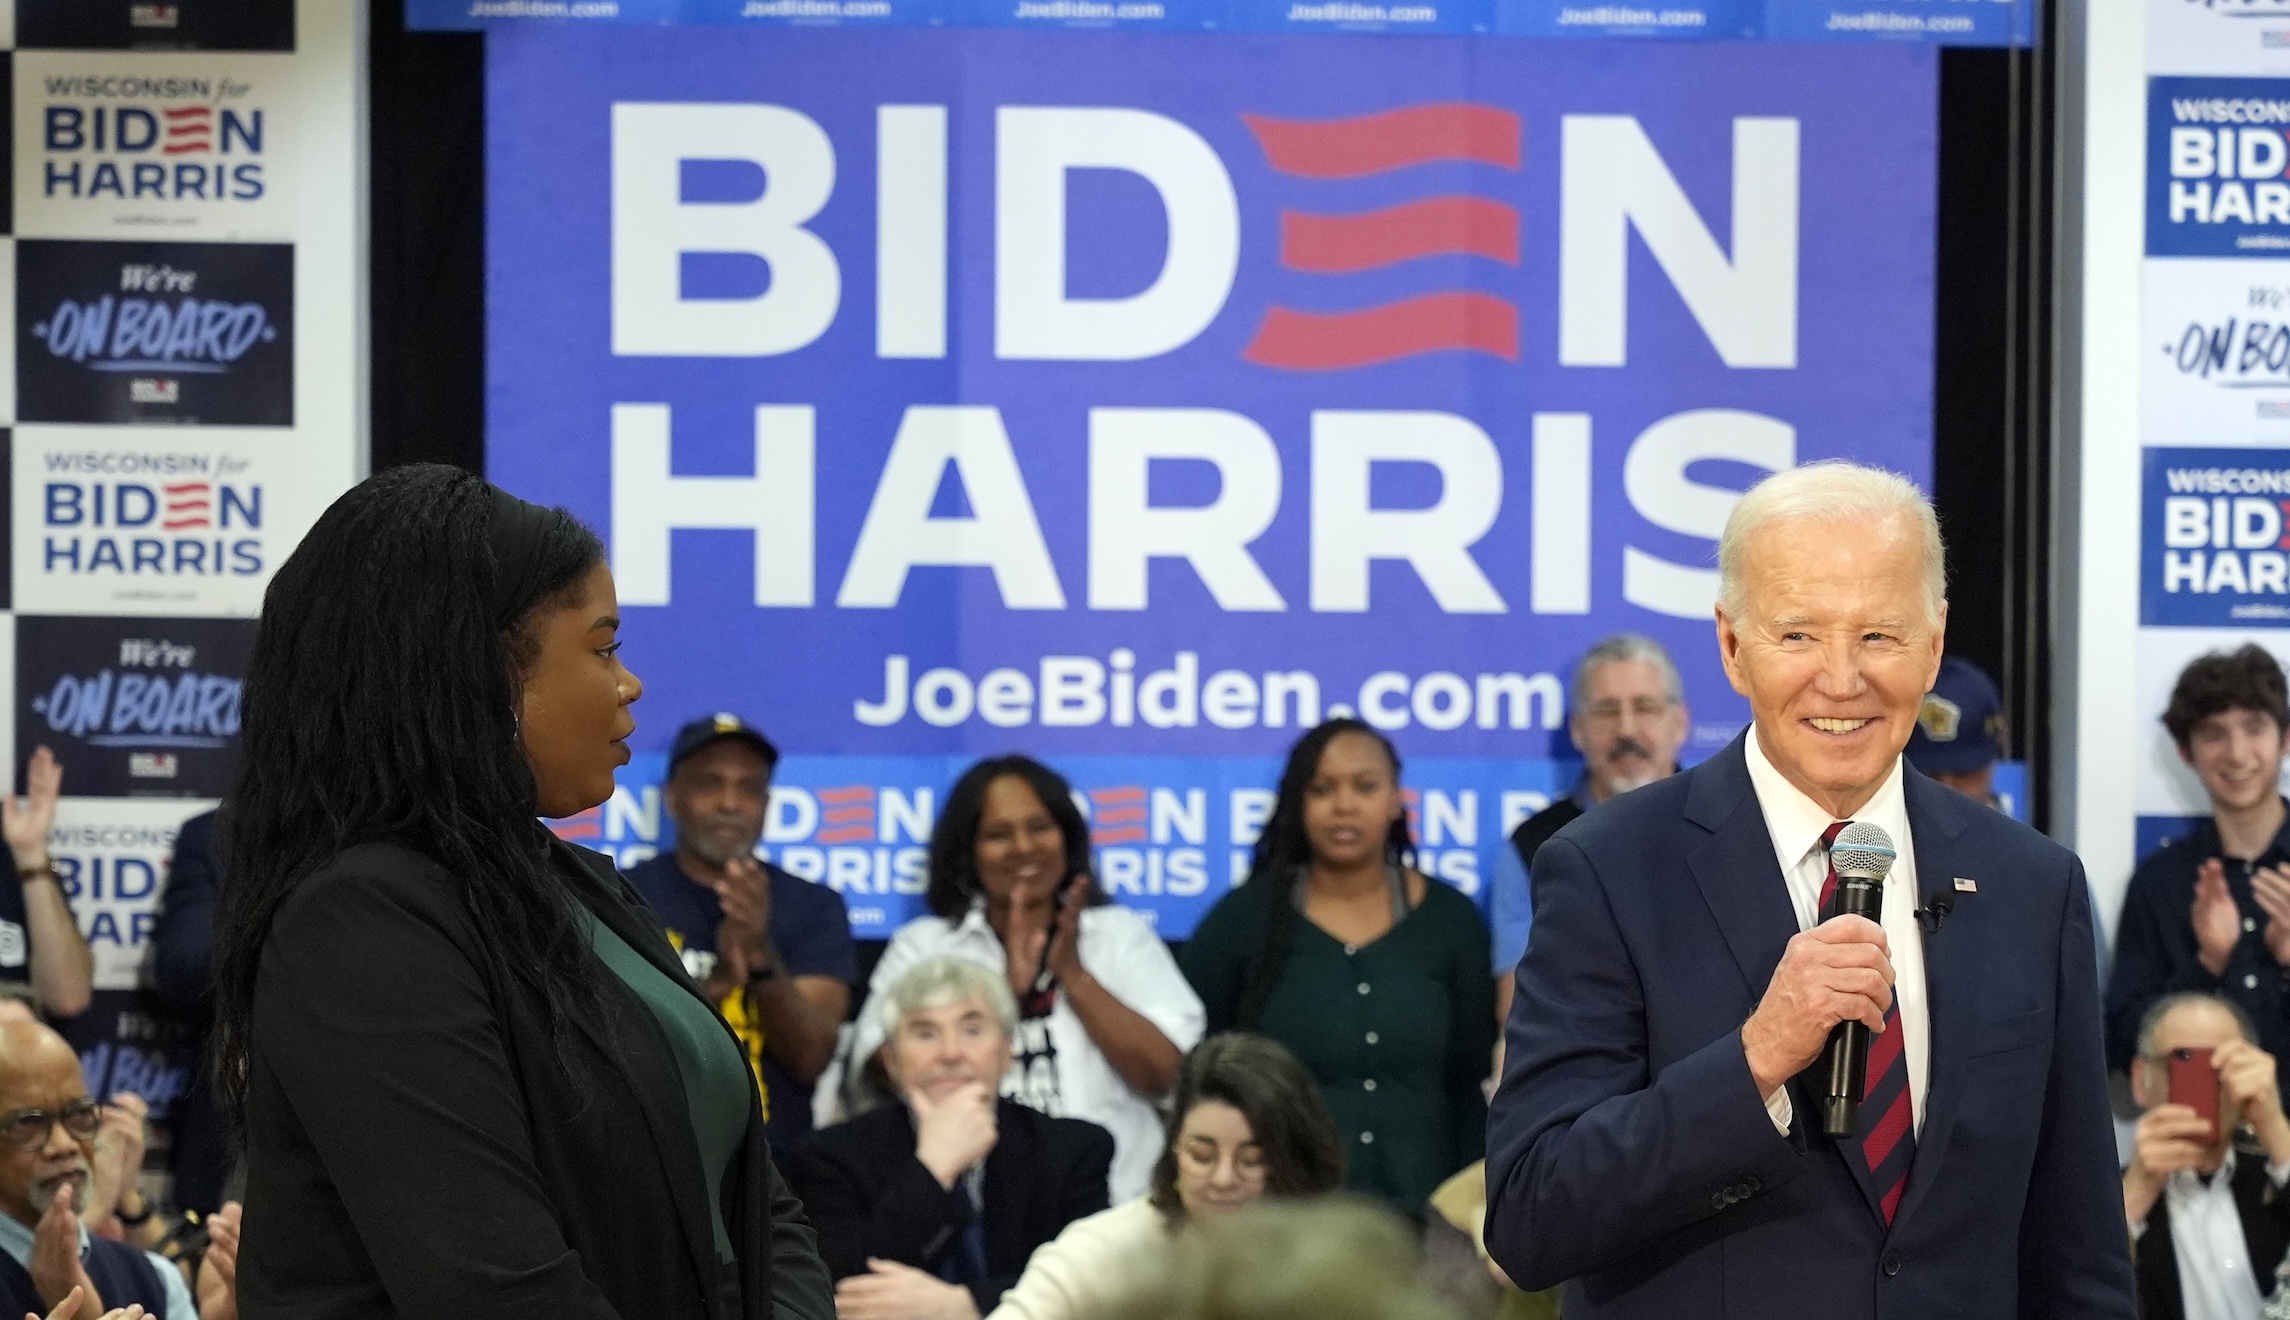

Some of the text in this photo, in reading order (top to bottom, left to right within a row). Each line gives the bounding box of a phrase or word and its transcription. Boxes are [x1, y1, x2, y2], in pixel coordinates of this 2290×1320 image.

[44, 77, 252, 102] WISCONSIN for
[2172, 98, 2290, 124] WISCON
[44, 106, 263, 155] BIDEN
[2169, 126, 2290, 179] BID
[44, 161, 265, 200] HARRIS
[610, 100, 1800, 371] BIDEN
[120, 264, 198, 293] We're
[49, 297, 267, 362] ON BOARD
[2177, 316, 2290, 379] ON BO
[44, 452, 252, 478] WISCONSIN for
[44, 483, 263, 531] BIDEN
[610, 403, 1798, 620] HARRIS
[2164, 496, 2290, 550] BID
[44, 537, 264, 576] HARRIS
[2163, 550, 2290, 595] HAR
[49, 668, 113, 737] ON
[854, 650, 1565, 731] JoeBiden.com
[762, 786, 935, 845] DEN
[57, 857, 171, 900] BID
[753, 846, 932, 894] RRIS
[1091, 848, 1209, 897] RIS
[1846, 883, 1870, 891] SHURE
